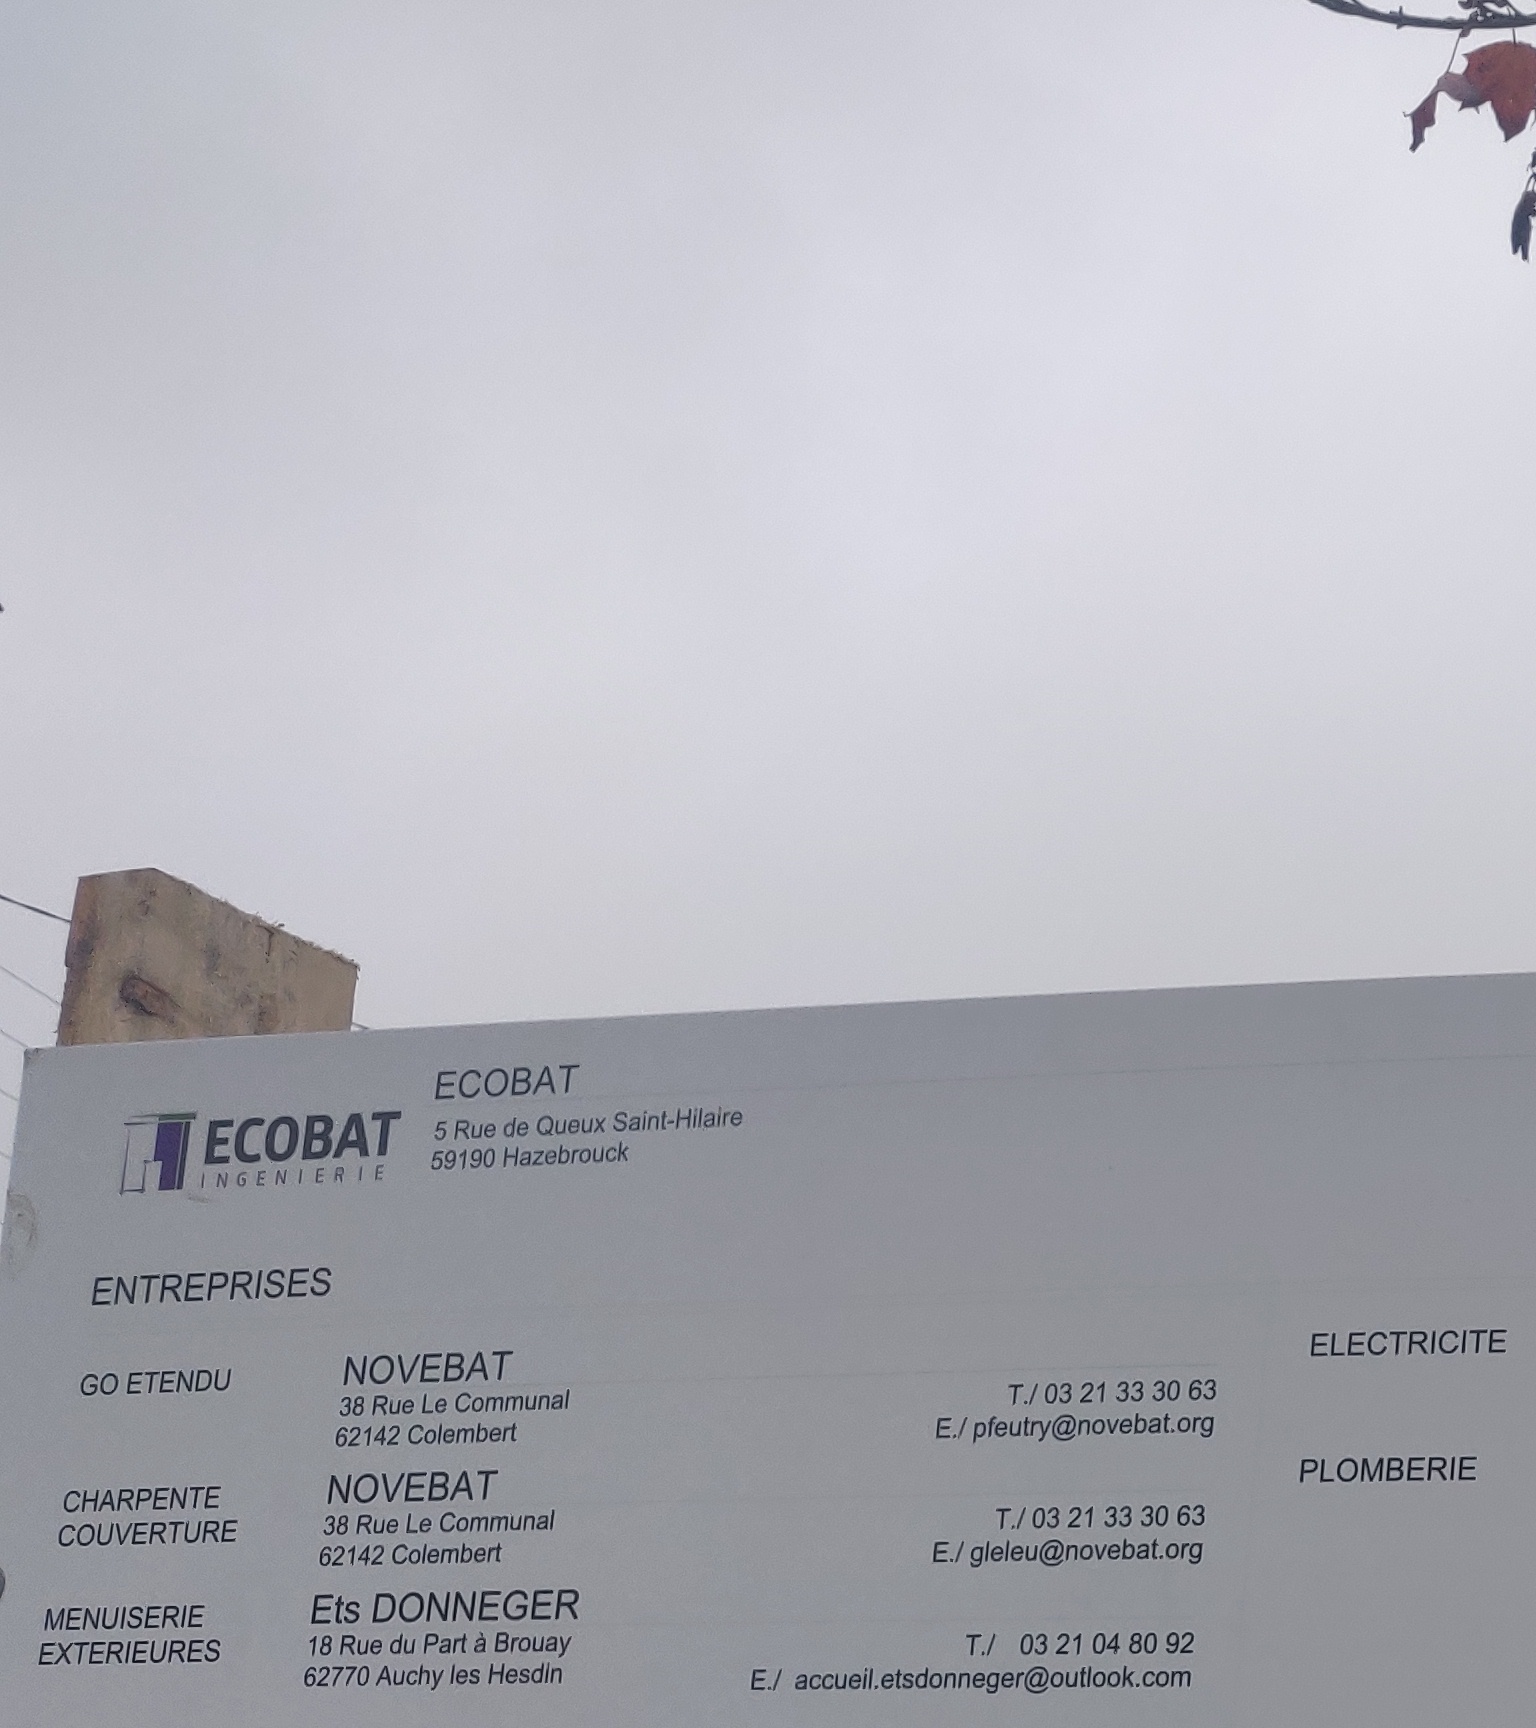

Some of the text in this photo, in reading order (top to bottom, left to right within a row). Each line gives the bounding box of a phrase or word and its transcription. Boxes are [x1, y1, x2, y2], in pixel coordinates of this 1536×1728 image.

[434, 1064, 581, 1100] ECOBAT
[203, 1110, 402, 1165] ECOBAT
[433, 1105, 744, 1141] 5 Rue de Queux Saint-Hilaire
[430, 1140, 630, 1171] 59190 Hazebrouck
[201, 1164, 384, 1189] INGENIERIE
[91, 1267, 332, 1306] ENTREPRISES
[1310, 1329, 1508, 1357] ELECTRICITE
[80, 1368, 232, 1397] GO ETENDU
[342, 1350, 514, 1386] NOVEBAT
[339, 1388, 570, 1417] 38 Rue Le Communal
[1007, 1378, 1217, 1406] T./ 03 21 33 30 63
[335, 1422, 518, 1448] 62142 Colembert
[935, 1412, 1215, 1444] E./ pfeutry@novebat.org
[1299, 1456, 1478, 1483] PLOMBERIE
[63, 1485, 222, 1513] CHARPENTE
[327, 1469, 499, 1505] NOVEBAT
[323, 1509, 555, 1536] 38 Rue Le Communal
[995, 1504, 1206, 1530] T./ 03 21 33 30 63
[58, 1519, 238, 1548] COUVERTURE
[319, 1542, 503, 1567] 62142 Colembert
[932, 1537, 1204, 1568] E./ gleleu@novebat.org
[44, 1604, 206, 1631] MENUISERIE
[310, 1588, 580, 1625] Ets DONNEGER
[38, 1638, 221, 1666] EXTERIEURES
[309, 1631, 573, 1659] 18 Rue du Part à Brouay
[965, 1631, 1195, 1657] T./ 03 21 04 80 92
[303, 1662, 563, 1692] 62770 Auchy les Hesdin
[750, 1665, 1192, 1695] E./ accueil.etsdonneger@outlook.com
